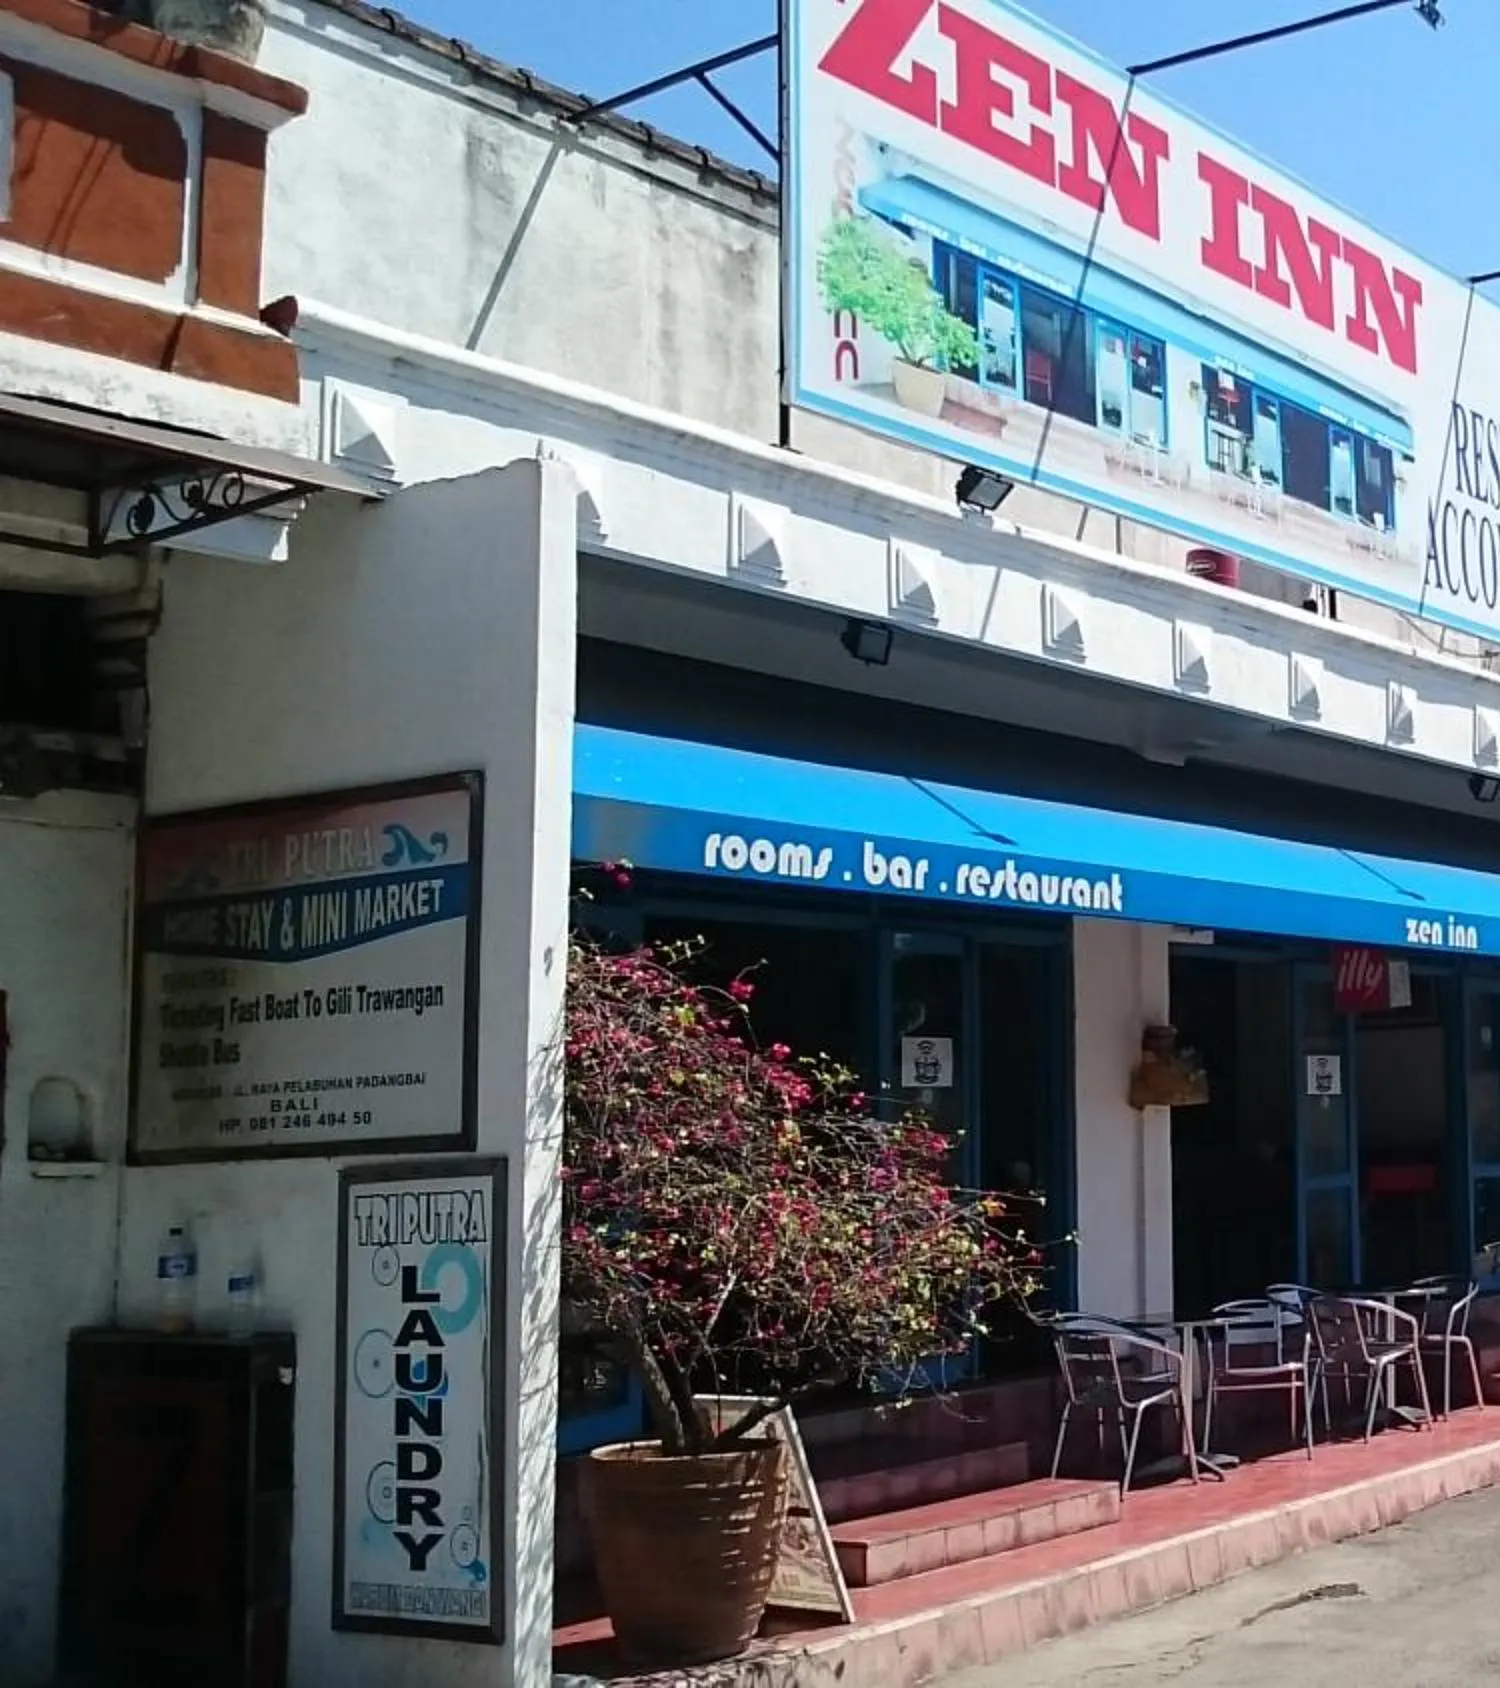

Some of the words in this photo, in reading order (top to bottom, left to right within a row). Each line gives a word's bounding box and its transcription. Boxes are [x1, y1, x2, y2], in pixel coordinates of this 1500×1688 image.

[818, 0, 1169, 241] ZEN
[1198, 150, 1422, 375] INN
[285, 827, 377, 879] PUTRA
[705, 833, 832, 880] rooms
[863, 842, 928, 891] bar
[956, 859, 1123, 912] restaurant
[225, 900, 276, 950] STAY
[280, 897, 295, 951] &
[301, 891, 347, 949] MINI
[354, 878, 445, 936] MARKET
[1406, 918, 1442, 945] zen
[1448, 915, 1477, 949] inn
[1338, 949, 1383, 998] illy
[230, 997, 261, 1024] Fast
[265, 992, 300, 1021] Boat
[303, 989, 323, 1017] To
[326, 985, 352, 1016] Gili
[356, 984, 444, 1016] Trawangan
[214, 1038, 240, 1065] Bus
[356, 1072, 427, 1089] PADANGBAI
[270, 1098, 318, 1113] BALI
[353, 1111, 372, 1126] 50
[354, 1194, 400, 1248] TRI
[401, 1190, 487, 1246] PUTRA
[393, 1266, 445, 1571] LAUNDRY
